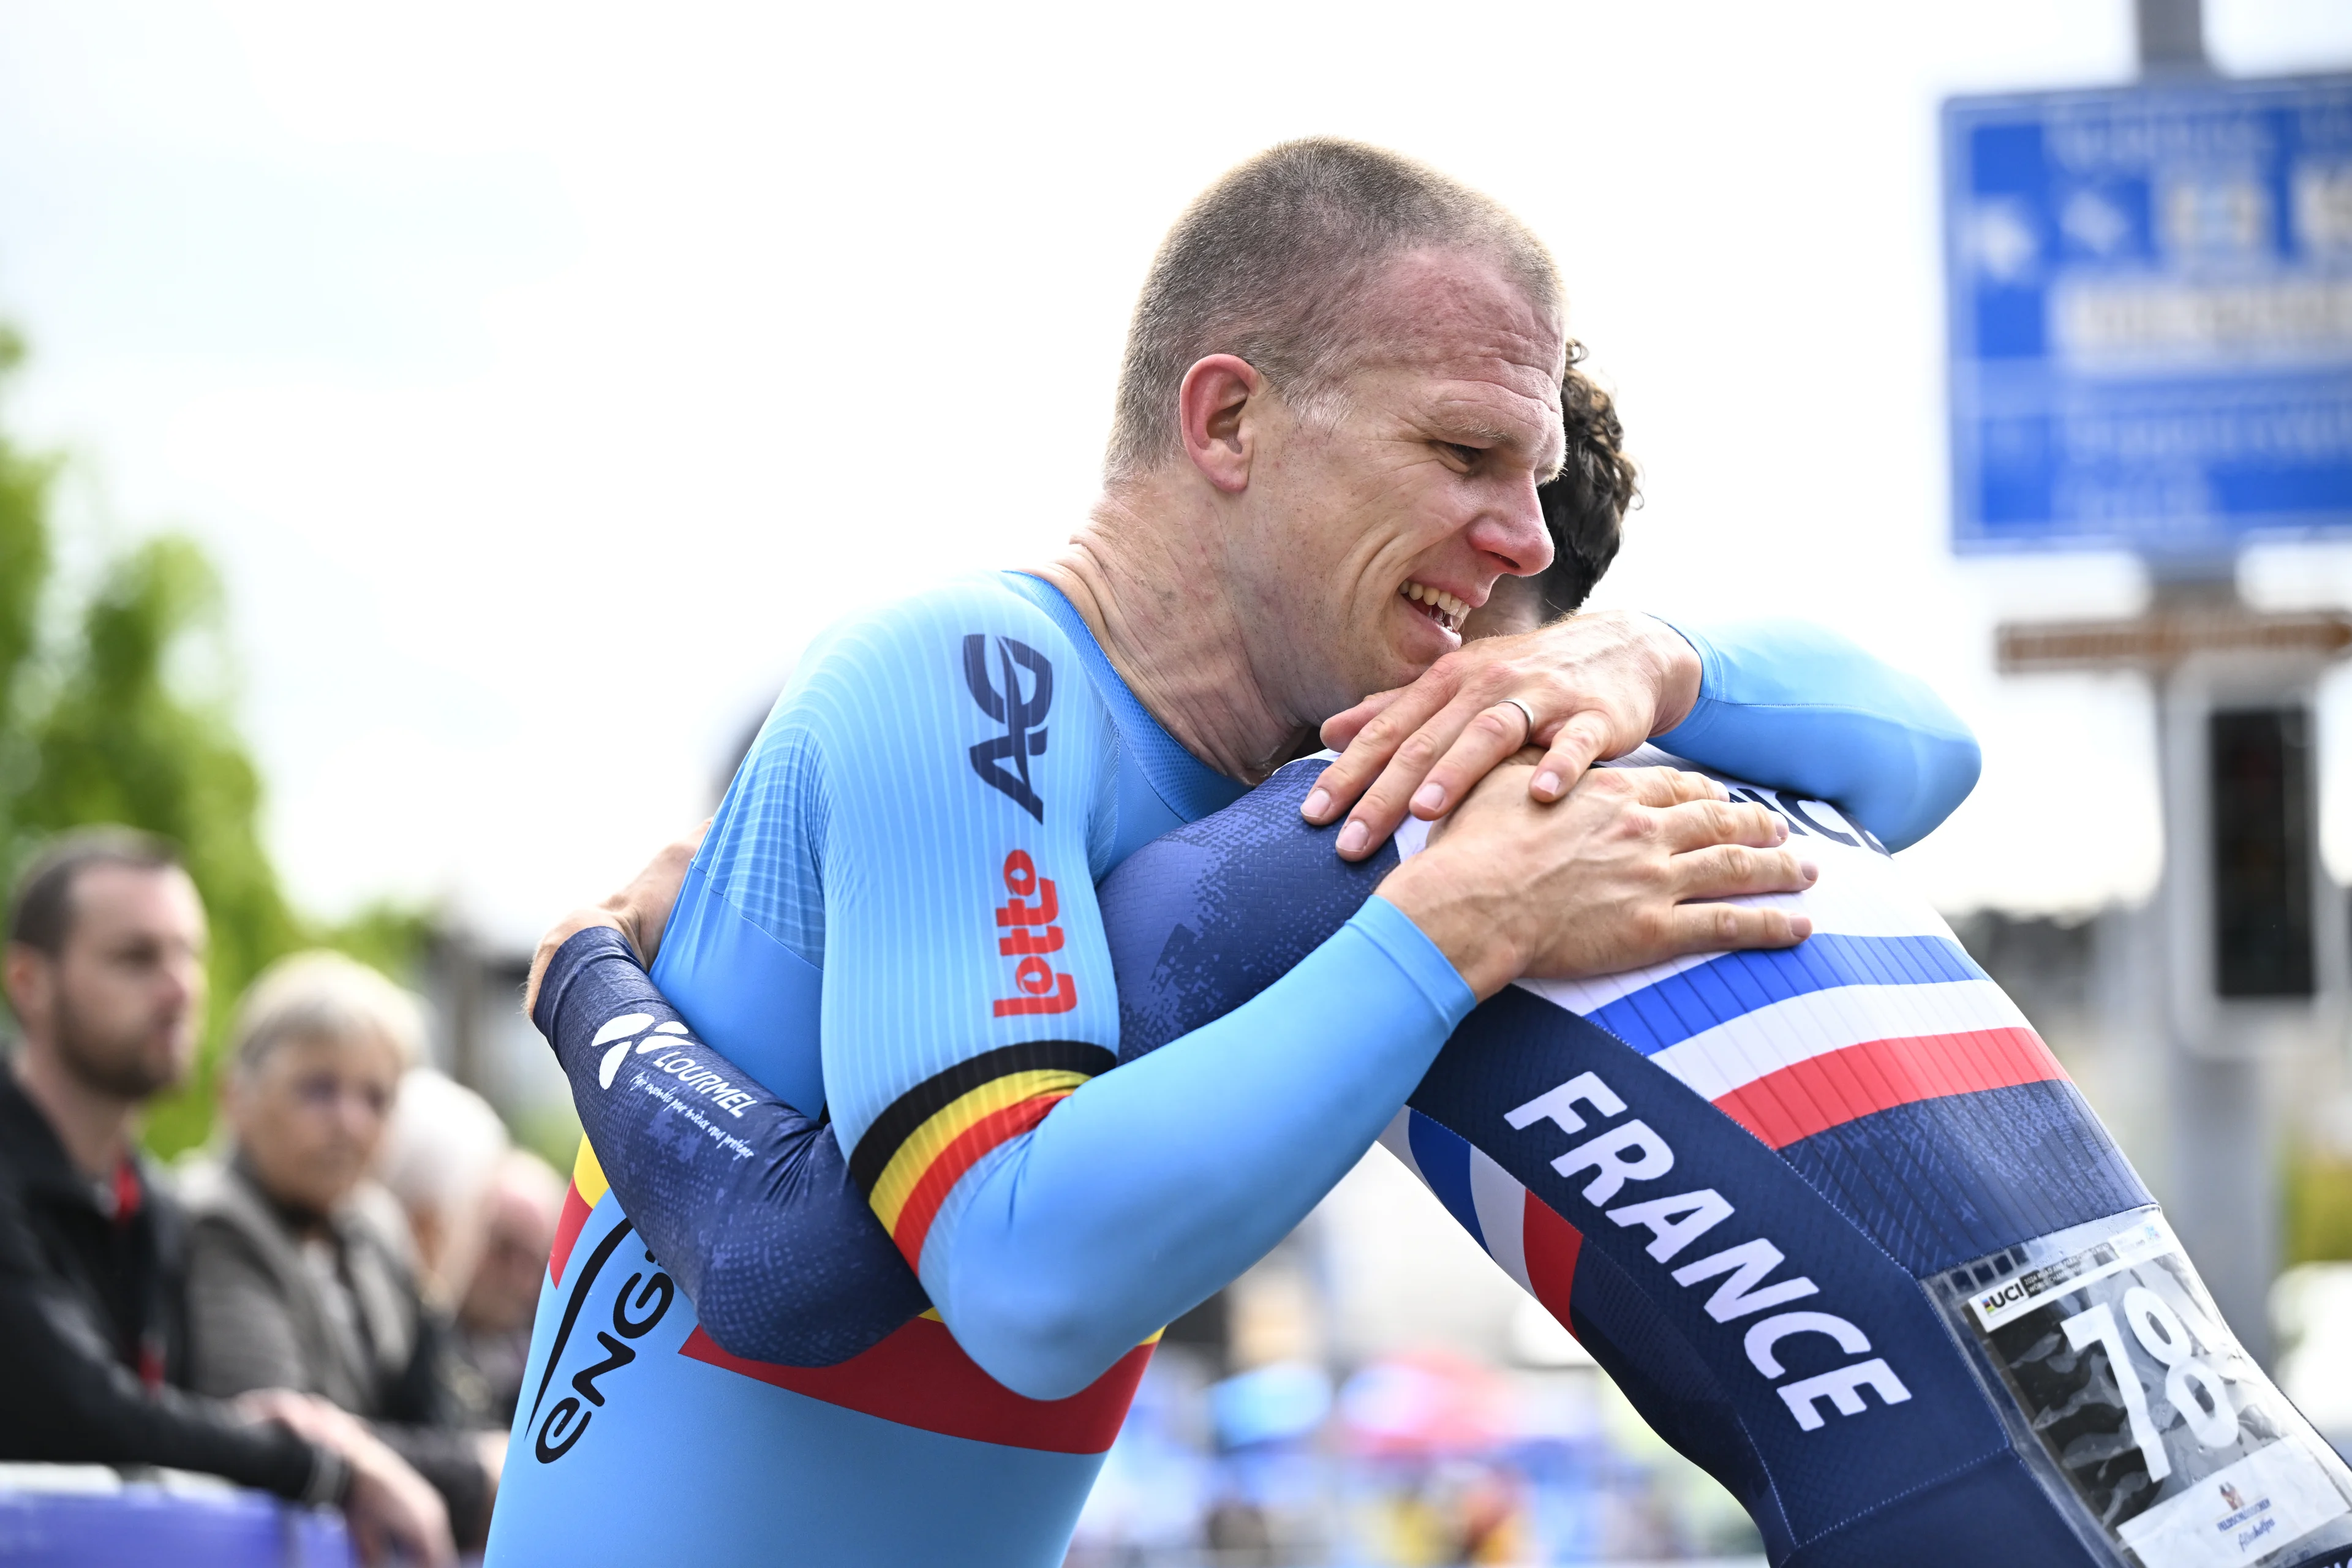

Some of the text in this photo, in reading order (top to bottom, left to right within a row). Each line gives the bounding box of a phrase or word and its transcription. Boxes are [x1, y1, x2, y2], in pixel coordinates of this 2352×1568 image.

[630, 1071, 650, 1091] Agir
[645, 1082, 678, 1102] ensemble
[653, 1051, 758, 1118] LOURMEL
[663, 1099, 688, 1113] pour
[707, 1126, 726, 1140] vous
[716, 1134, 755, 1161] protéger
[1504, 1071, 1912, 1431] FRANCE
[2024, 1275, 2038, 1286] 2024
[1989, 1283, 2024, 1308] UCI
[2060, 1286, 2239, 1483] 78
